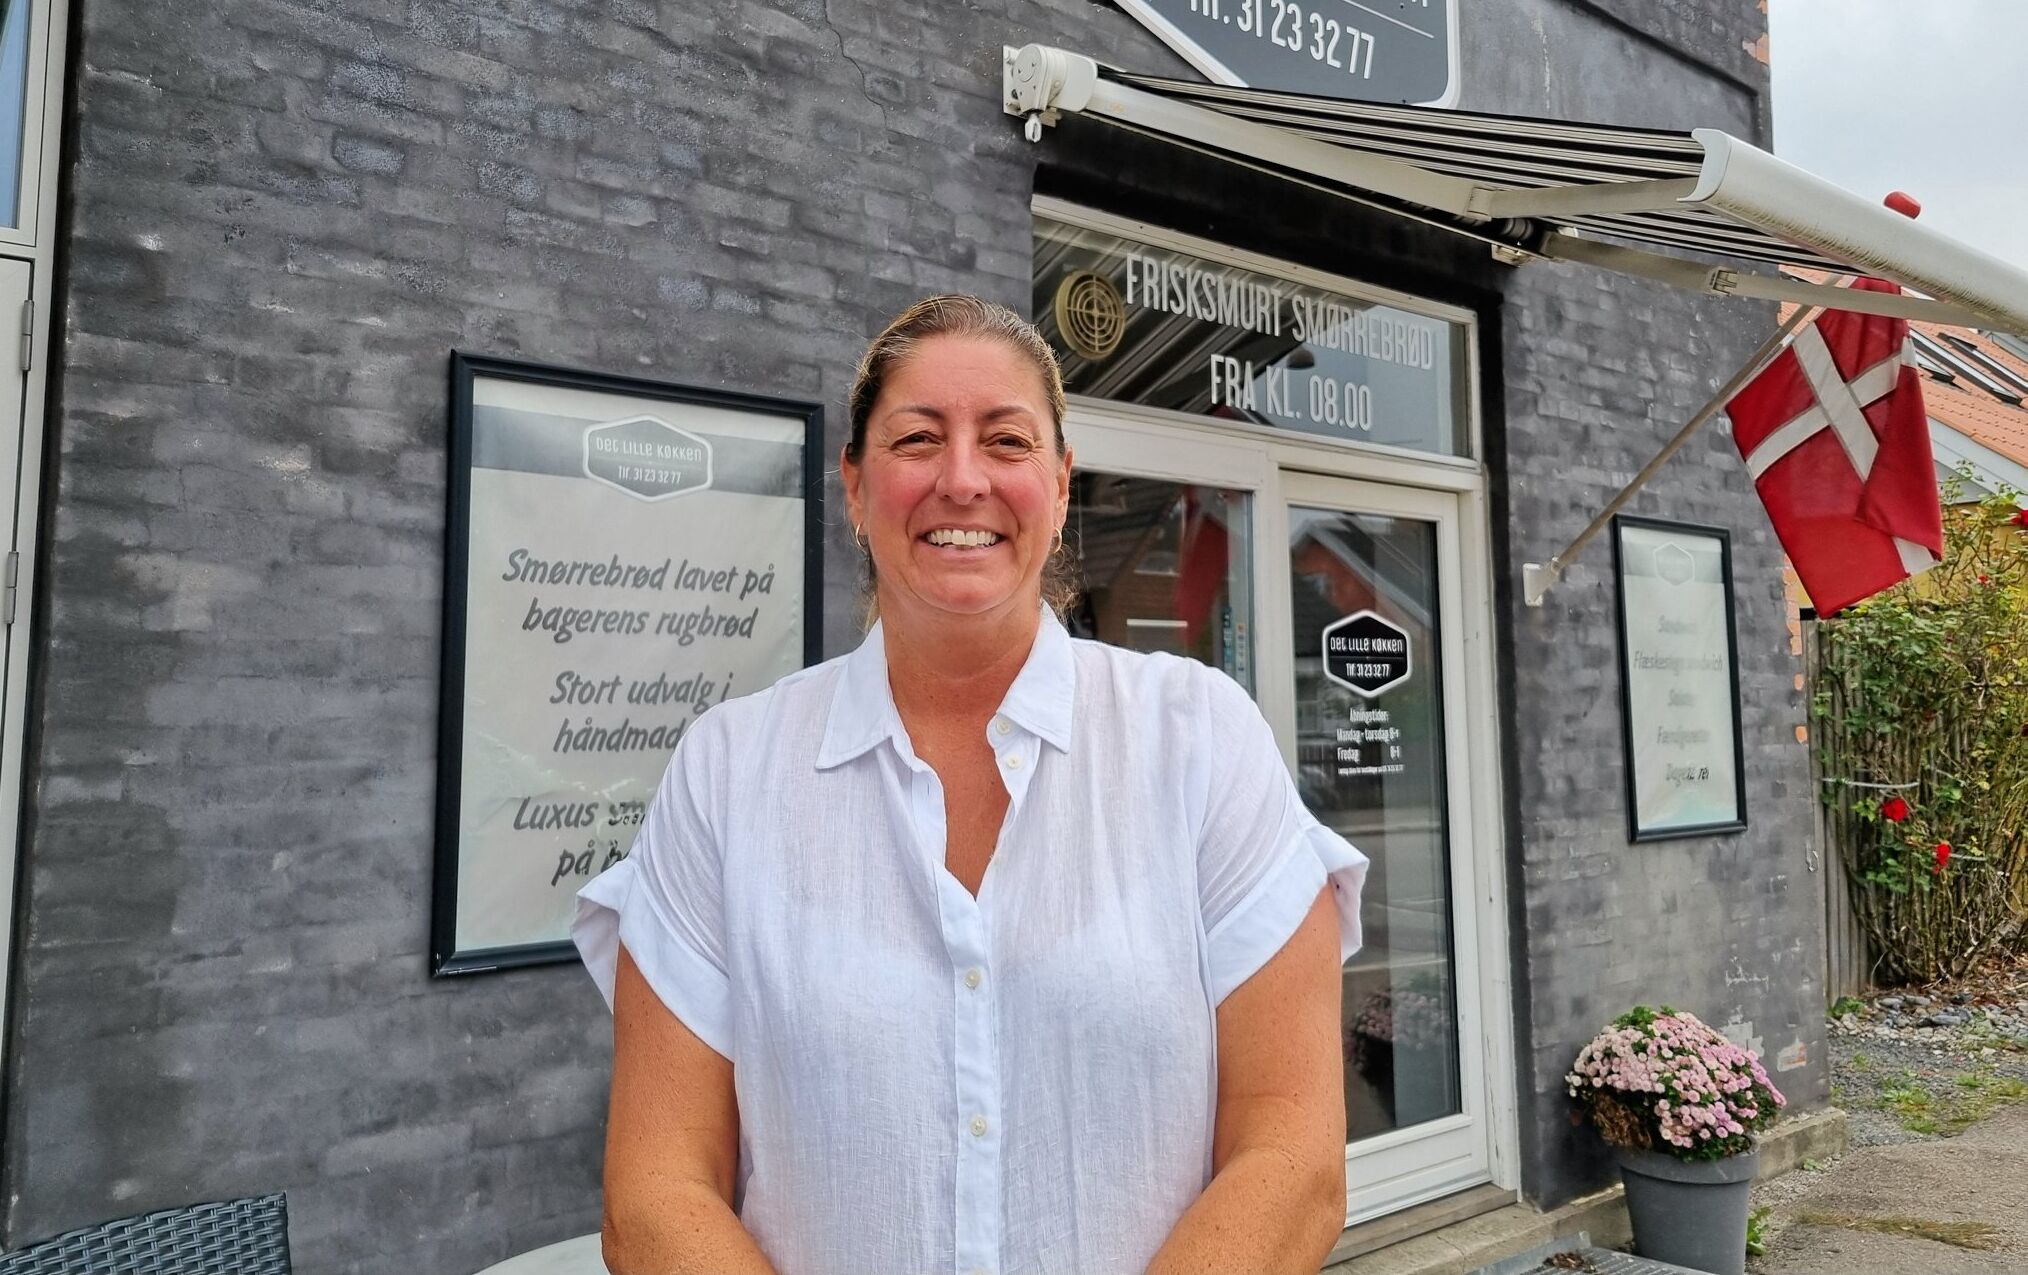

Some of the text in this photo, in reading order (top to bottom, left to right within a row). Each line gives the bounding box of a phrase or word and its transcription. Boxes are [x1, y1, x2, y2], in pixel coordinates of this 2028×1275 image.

[1237, 0, 1263, 37] 31
[1271, 0, 1303, 51] 23
[1309, 12, 1341, 68] 32
[1346, 26, 1375, 79] 77
[1125, 252, 1433, 370] FRISKSMURT SMØRREBRØD
[1210, 354, 1372, 431] FRA KL. 08.00
[634, 467, 643, 481] 31
[645, 468, 656, 482] 23
[659, 470, 670, 484] 32
[671, 471, 682, 484] 77
[502, 549, 776, 600] Smørrebrød lavet på
[522, 597, 759, 646] bagerens rugbrød
[550, 670, 734, 715] Stort udvalg i
[553, 717, 690, 752] håndmad
[513, 796, 599, 831] Luxus
[551, 840, 596, 886] på
